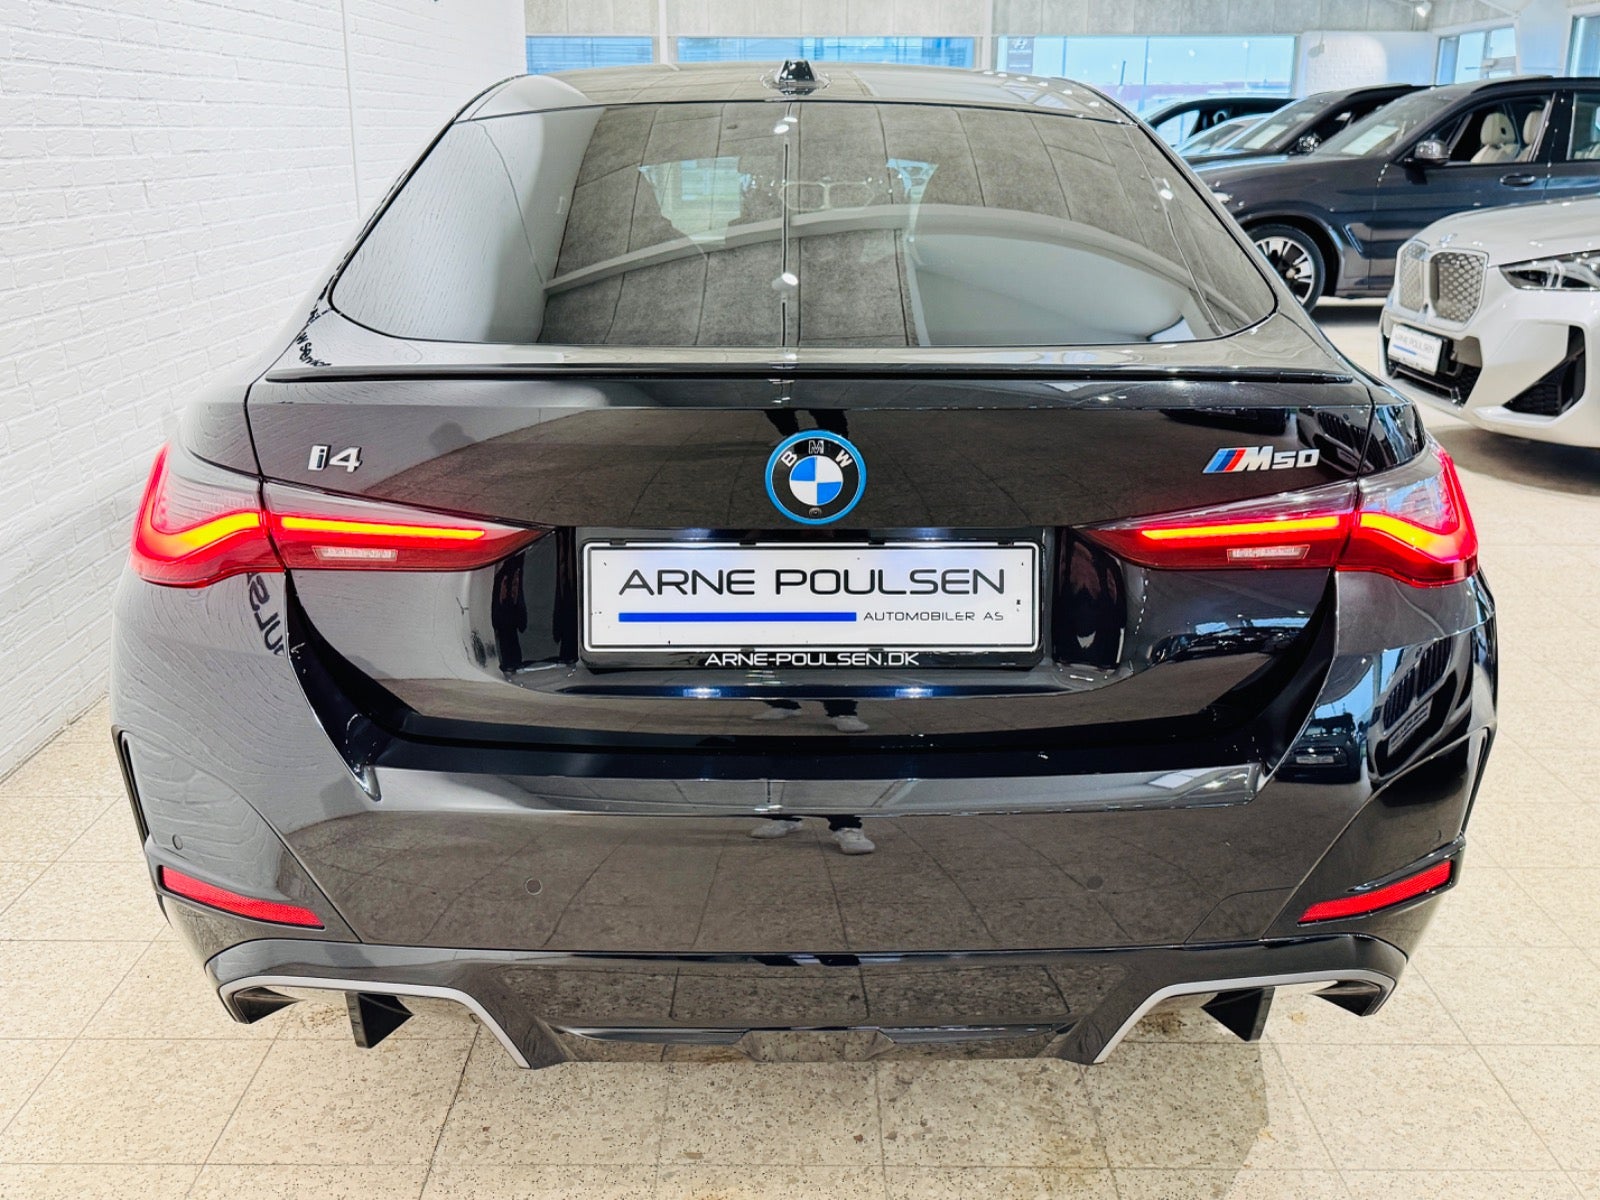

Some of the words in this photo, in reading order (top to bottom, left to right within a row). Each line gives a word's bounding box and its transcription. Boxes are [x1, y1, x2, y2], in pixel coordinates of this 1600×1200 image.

[307, 445, 363, 473] i4
[781, 440, 853, 468] BMW
[1231, 446, 1320, 472] M50
[618, 569, 755, 595] ARNE
[775, 569, 1004, 595] POULSEN
[863, 611, 975, 621] AUTOMOBILER
[983, 611, 1004, 621] AS
[704, 653, 920, 667] ARNE-POULSEN.DK
